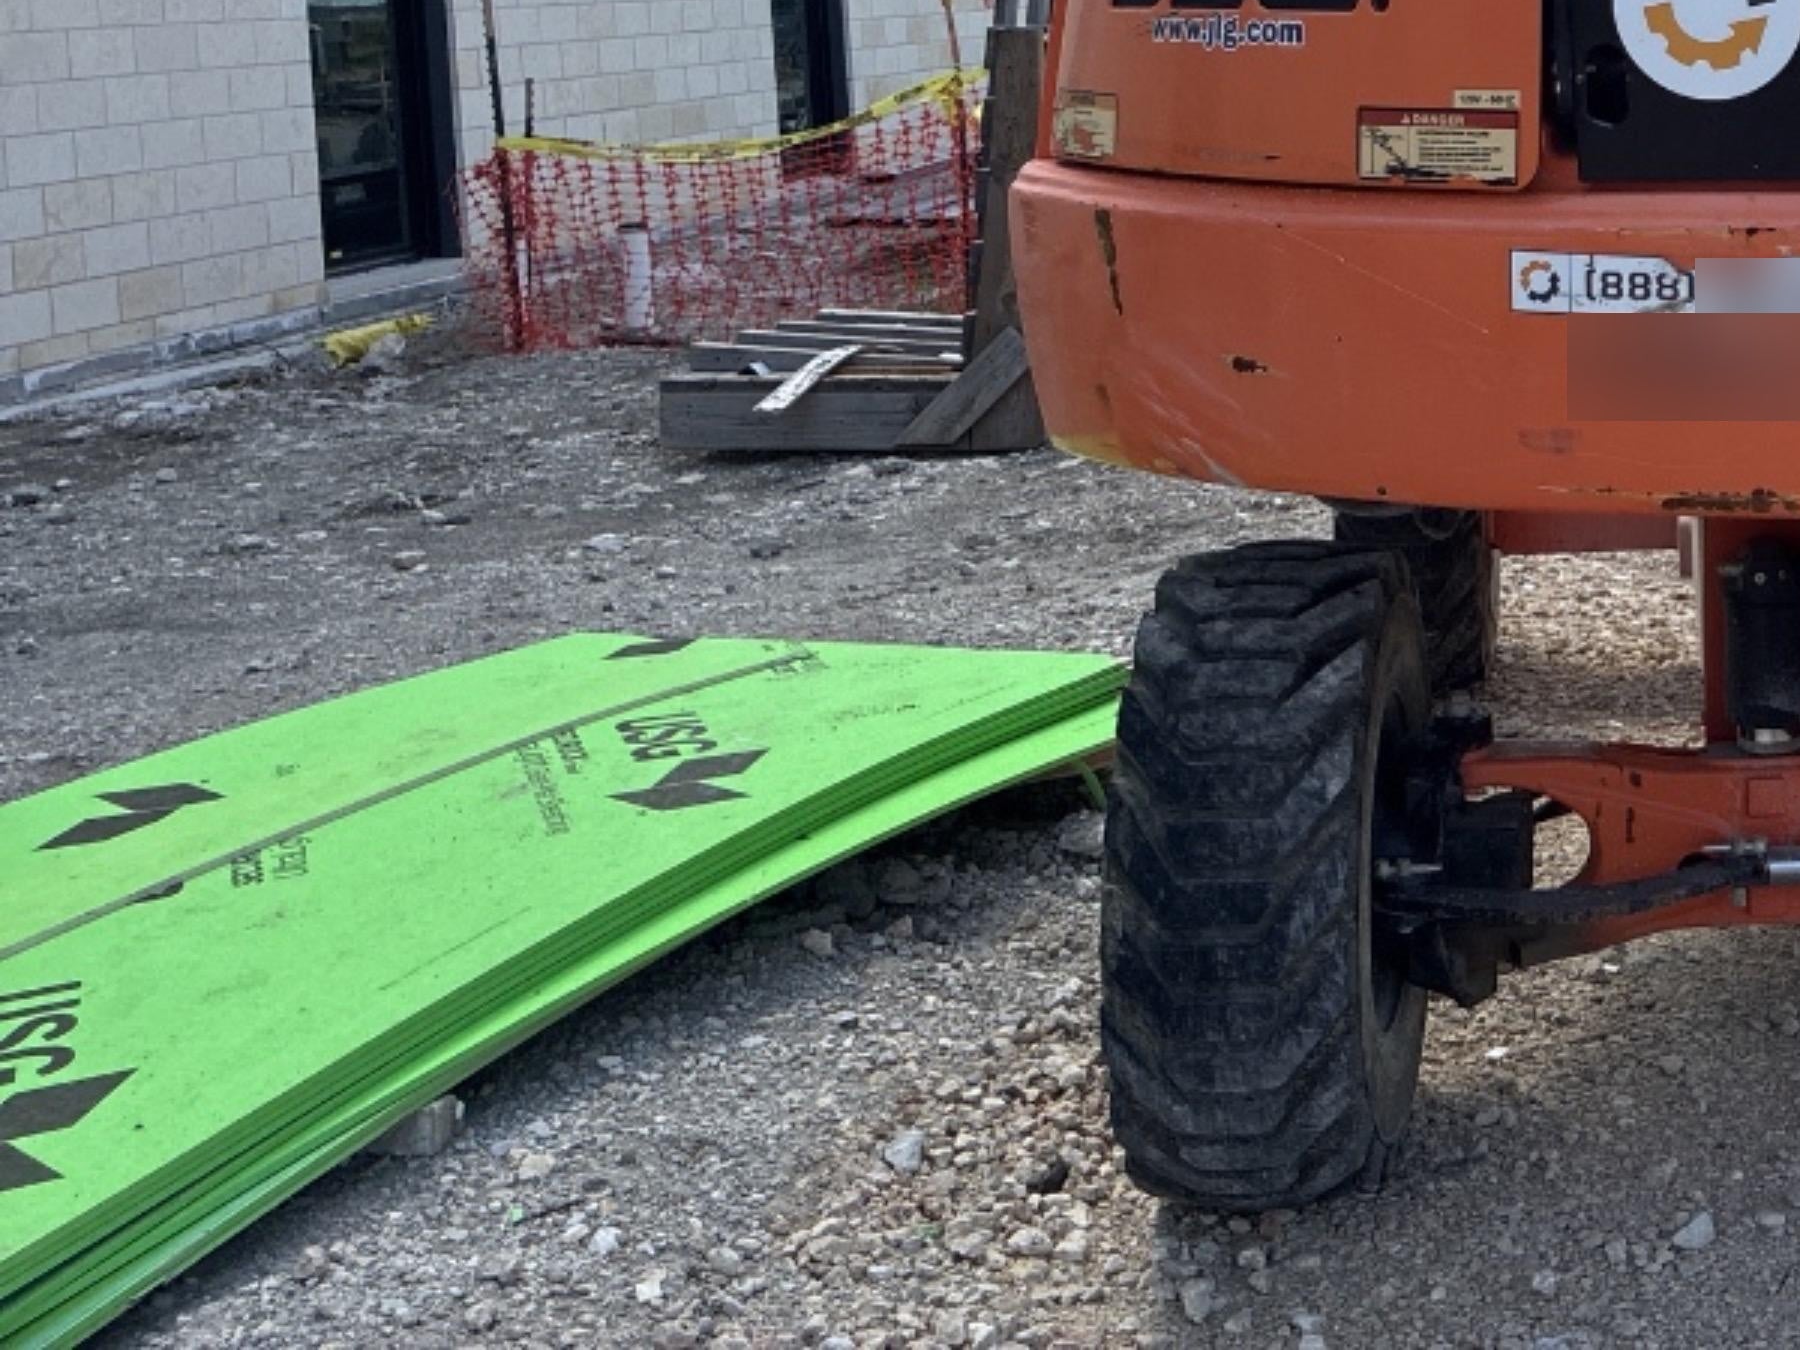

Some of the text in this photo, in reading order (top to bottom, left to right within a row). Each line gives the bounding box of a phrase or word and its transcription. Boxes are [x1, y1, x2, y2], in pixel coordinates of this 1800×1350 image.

[1153, 11, 1304, 50] www.jlg.com
[1586, 271, 1695, 301] (888)
[615, 711, 718, 762] USG
